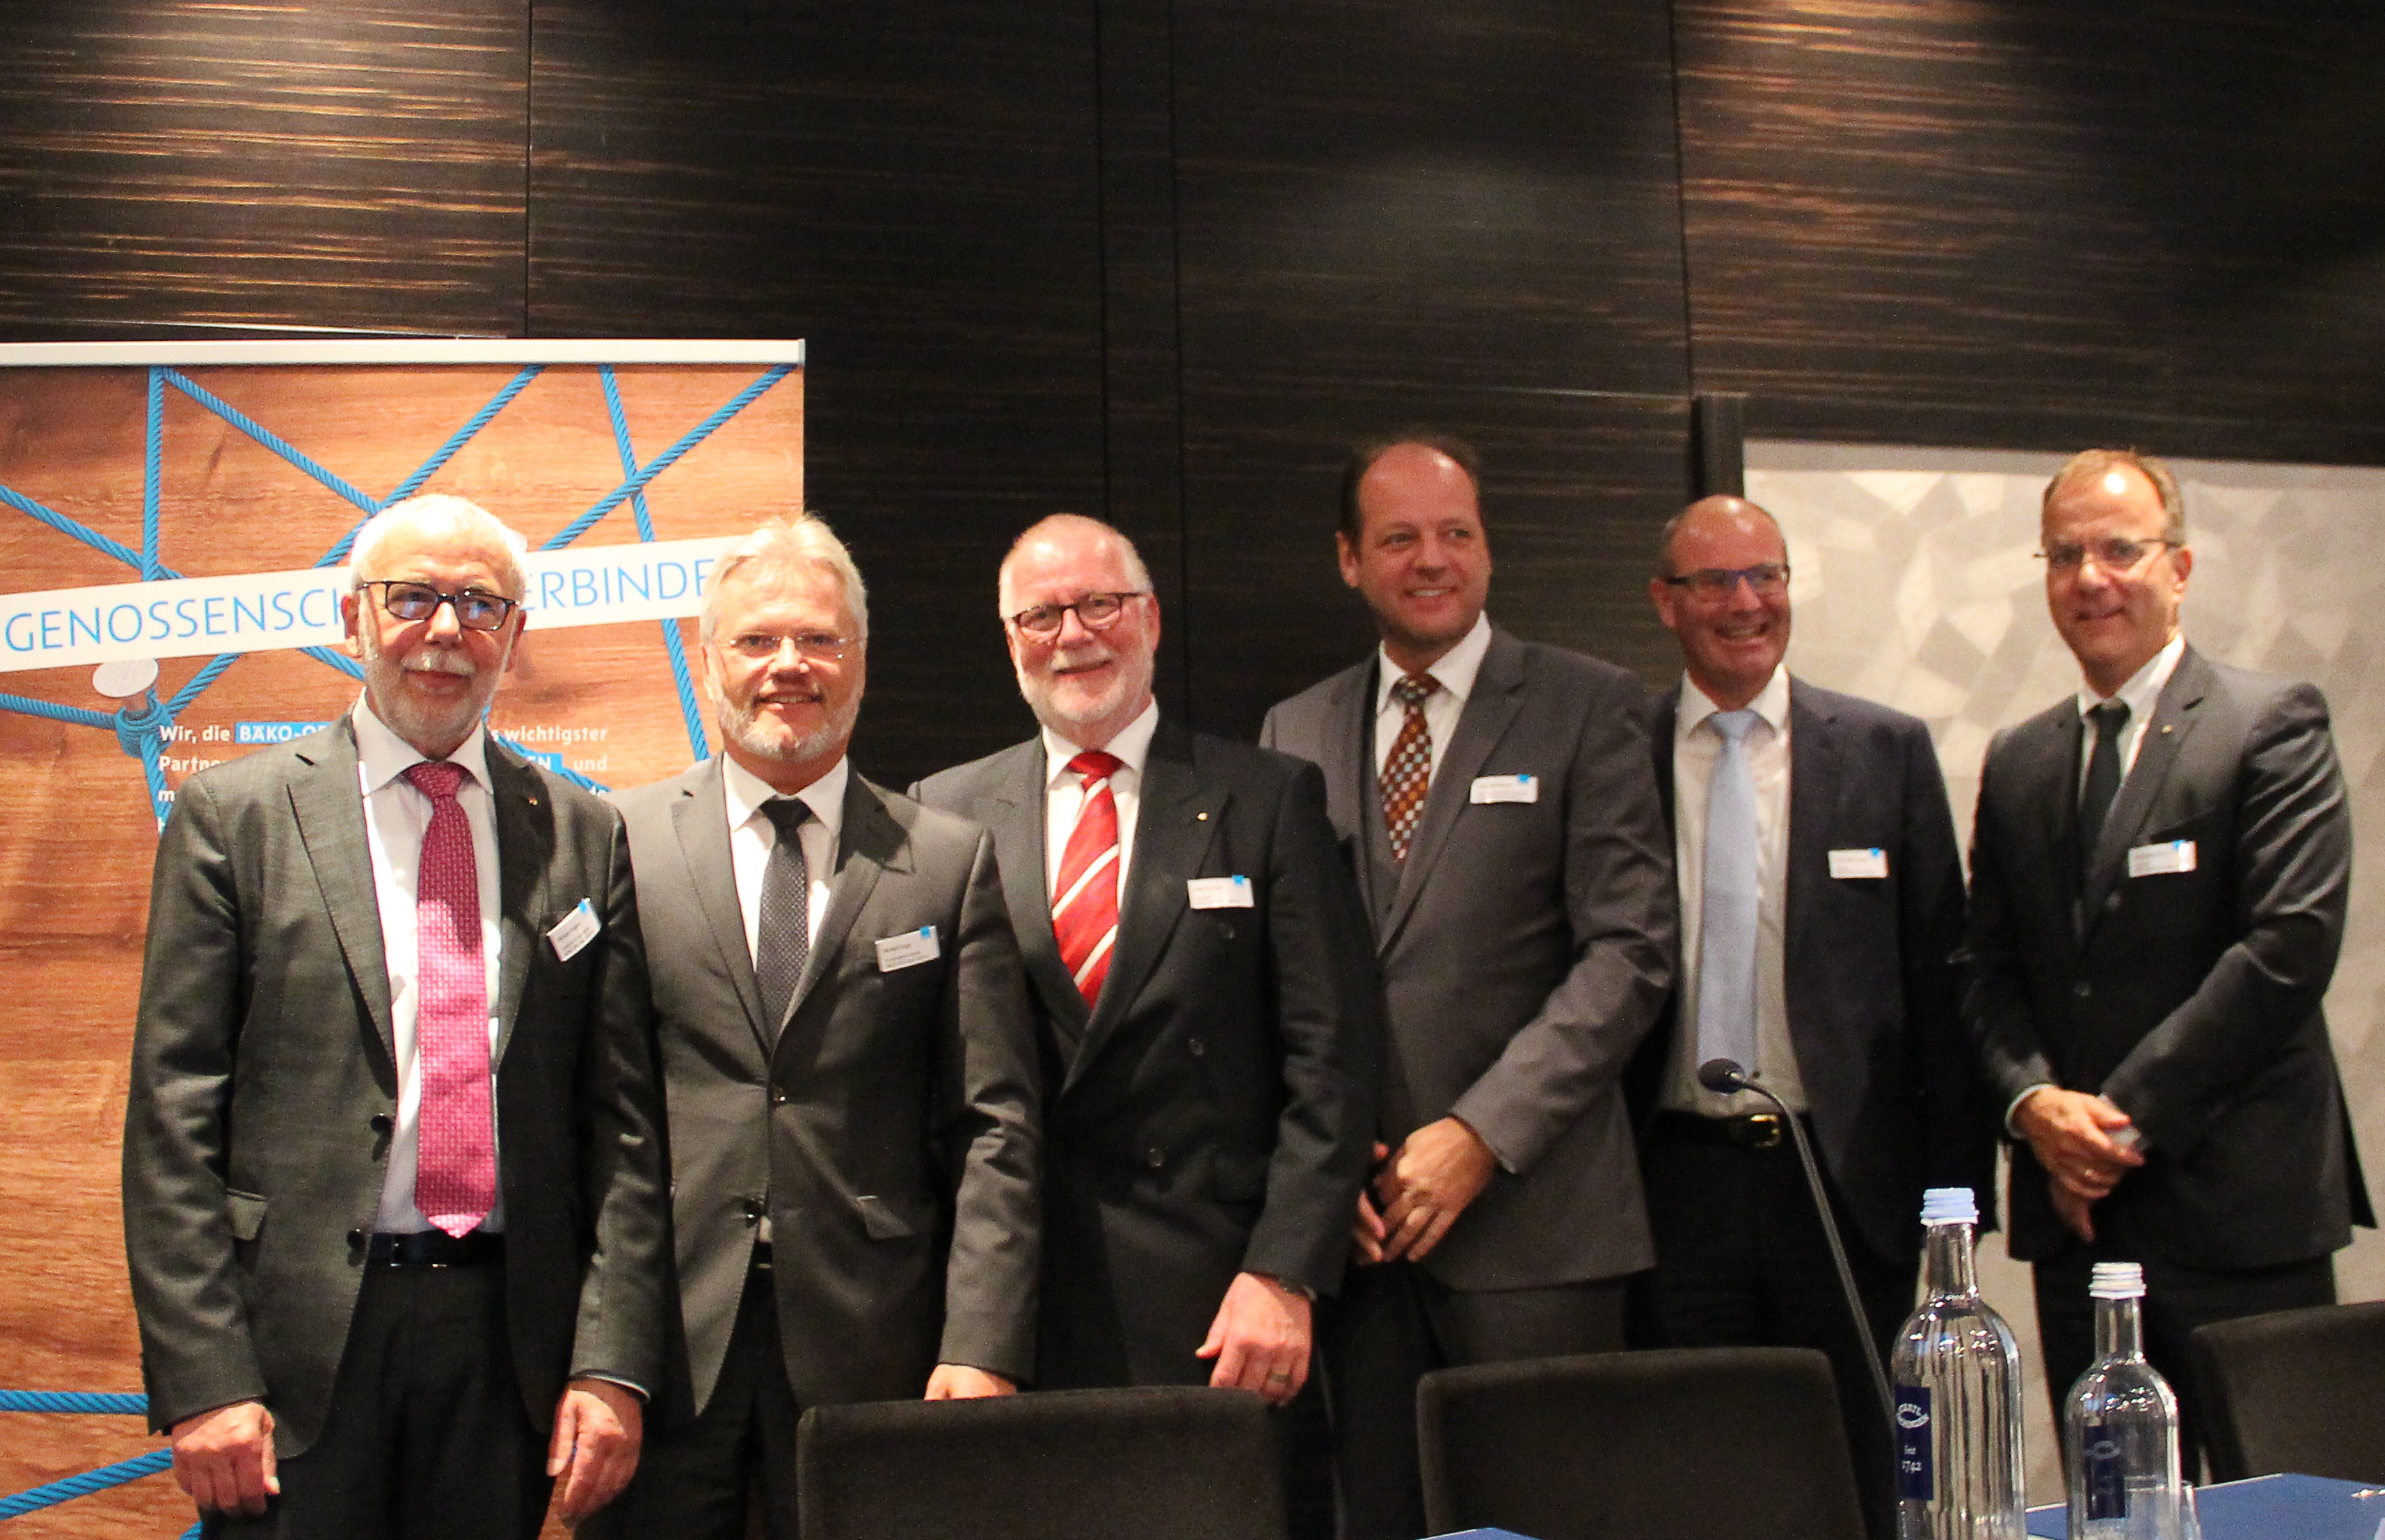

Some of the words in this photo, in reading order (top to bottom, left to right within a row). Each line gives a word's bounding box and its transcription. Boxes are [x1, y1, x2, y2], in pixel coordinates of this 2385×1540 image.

[159, 725, 197, 743] Wir,
[202, 725, 231, 741] die
[504, 725, 609, 745] wichtigster
[573, 755, 607, 771] und
